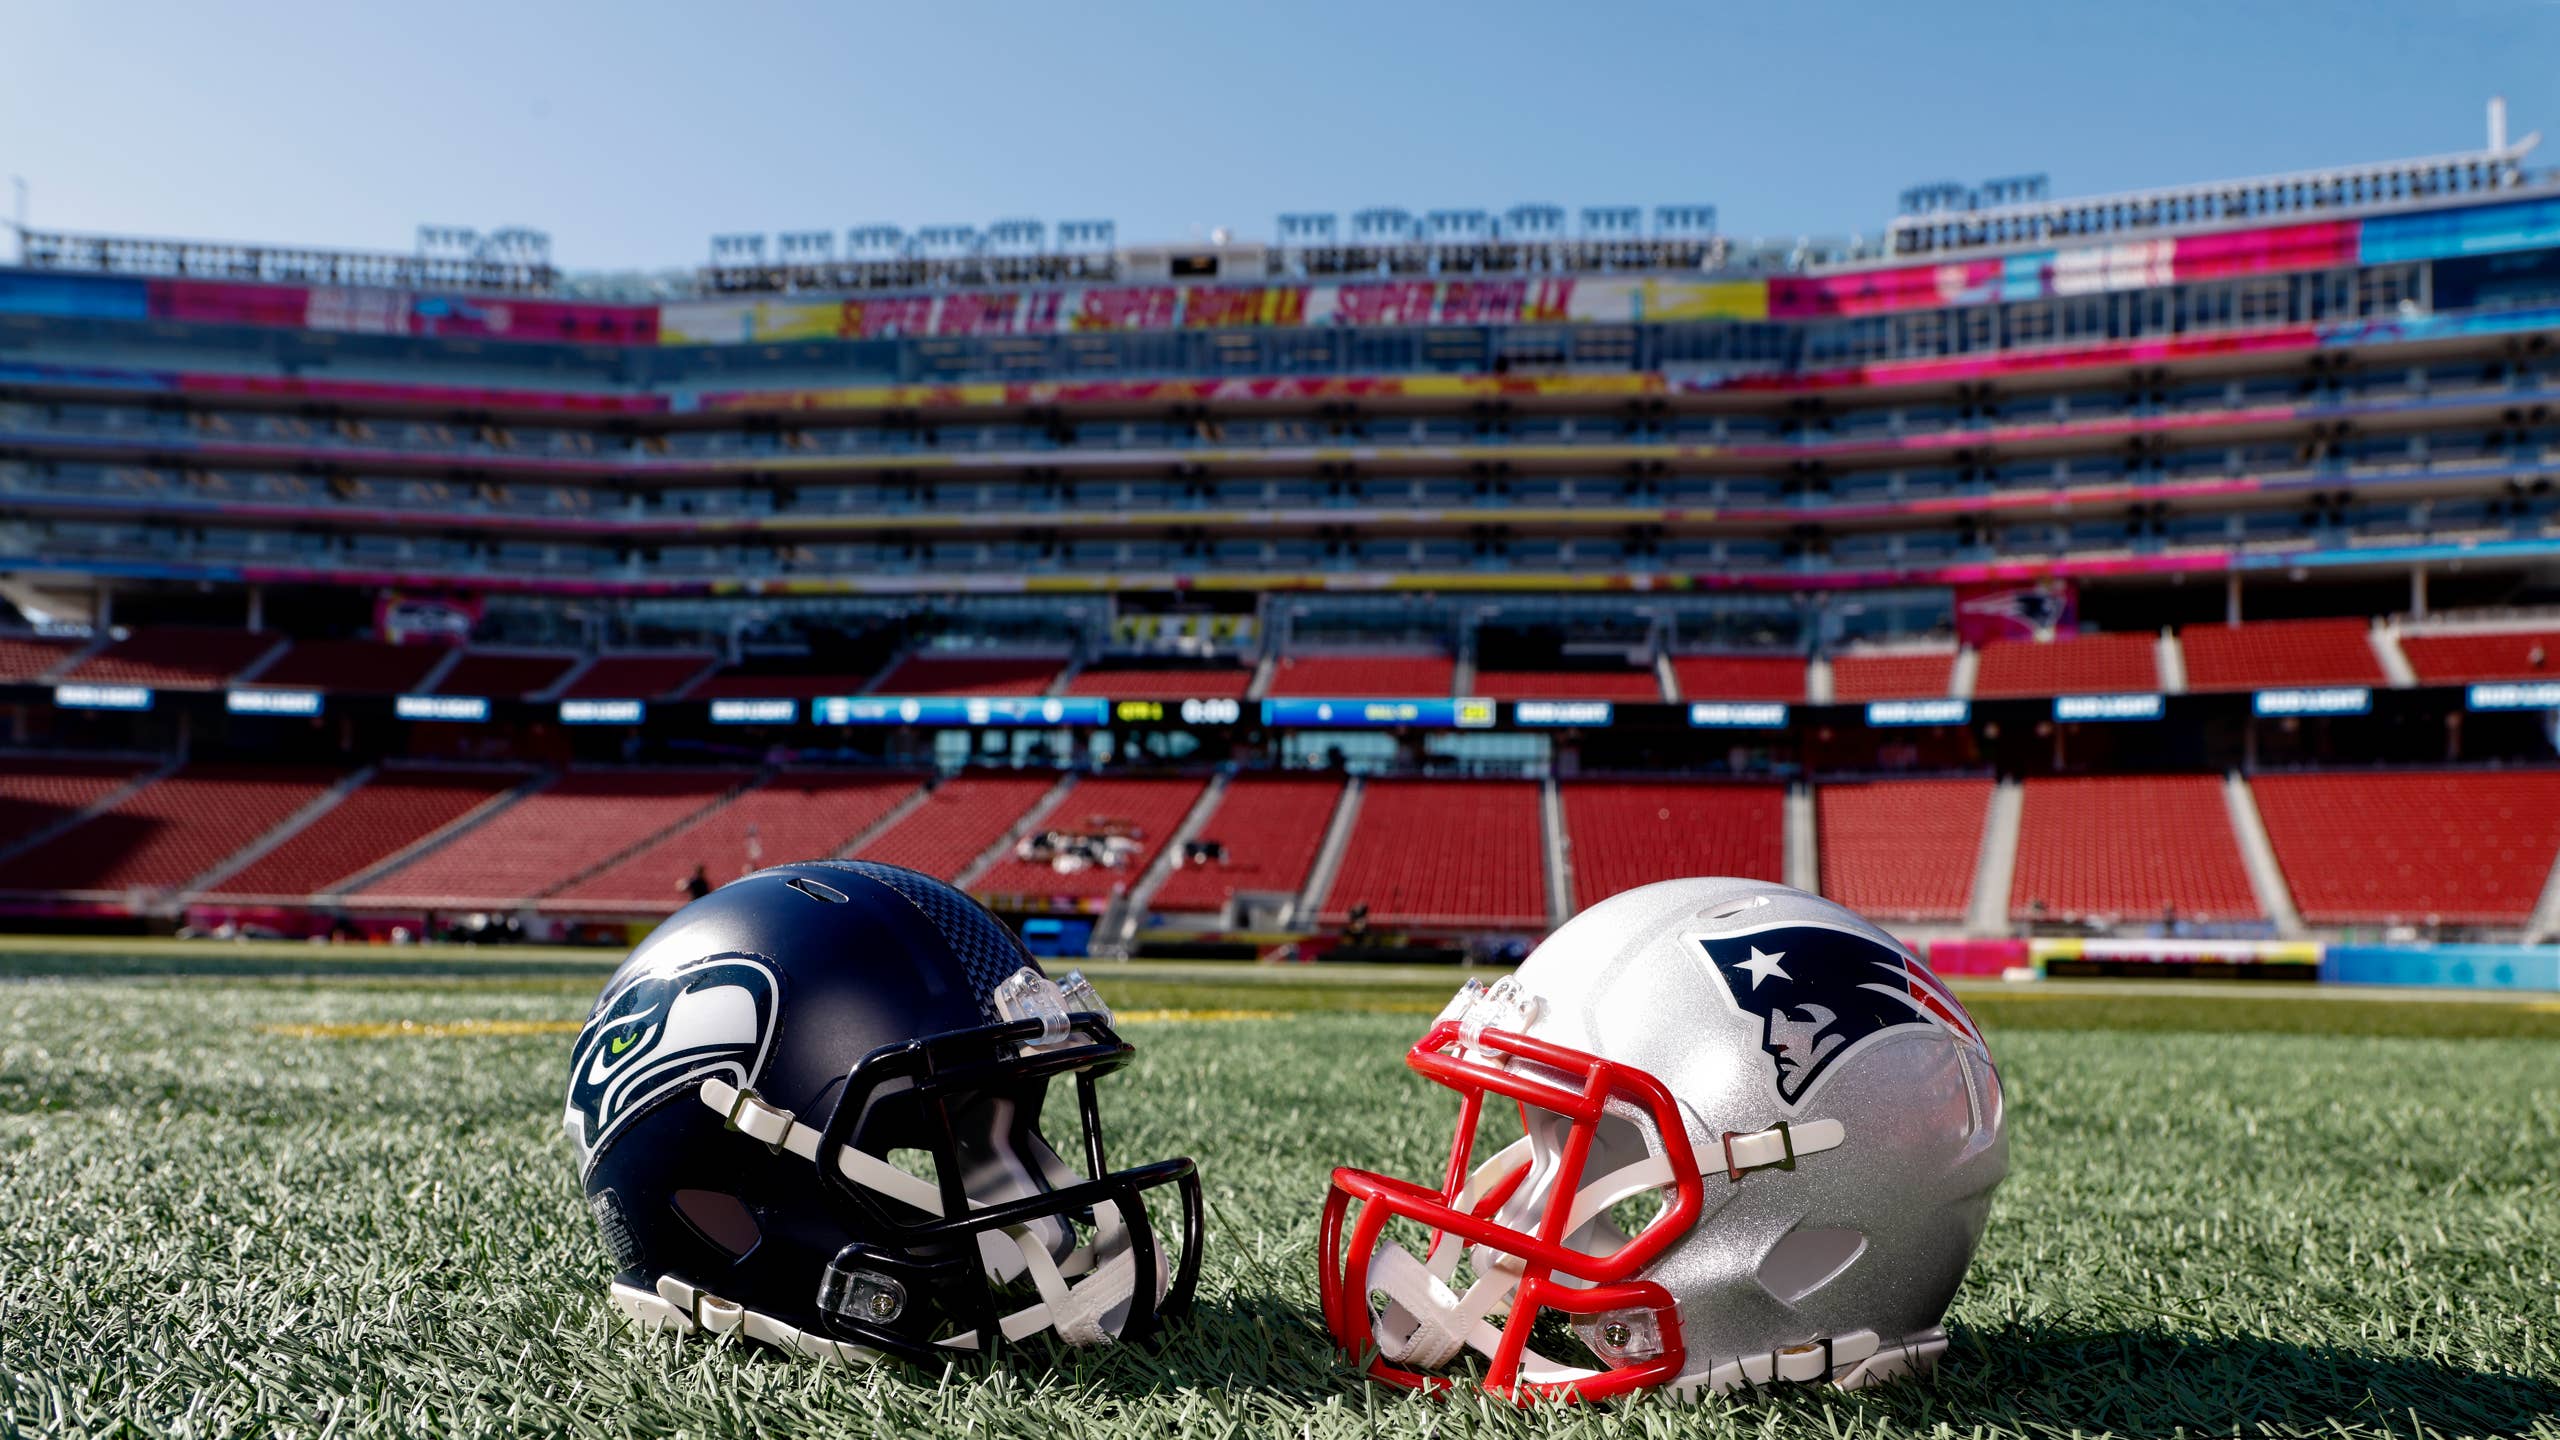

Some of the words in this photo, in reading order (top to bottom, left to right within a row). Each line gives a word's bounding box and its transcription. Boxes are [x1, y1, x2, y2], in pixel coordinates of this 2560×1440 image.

[839, 297, 934, 339] SUPER
[938, 293, 1022, 336] BOWL
[1078, 286, 1177, 331] SUPER
[1333, 281, 1437, 325] SUPER
[1440, 279, 1527, 323] BOWL
